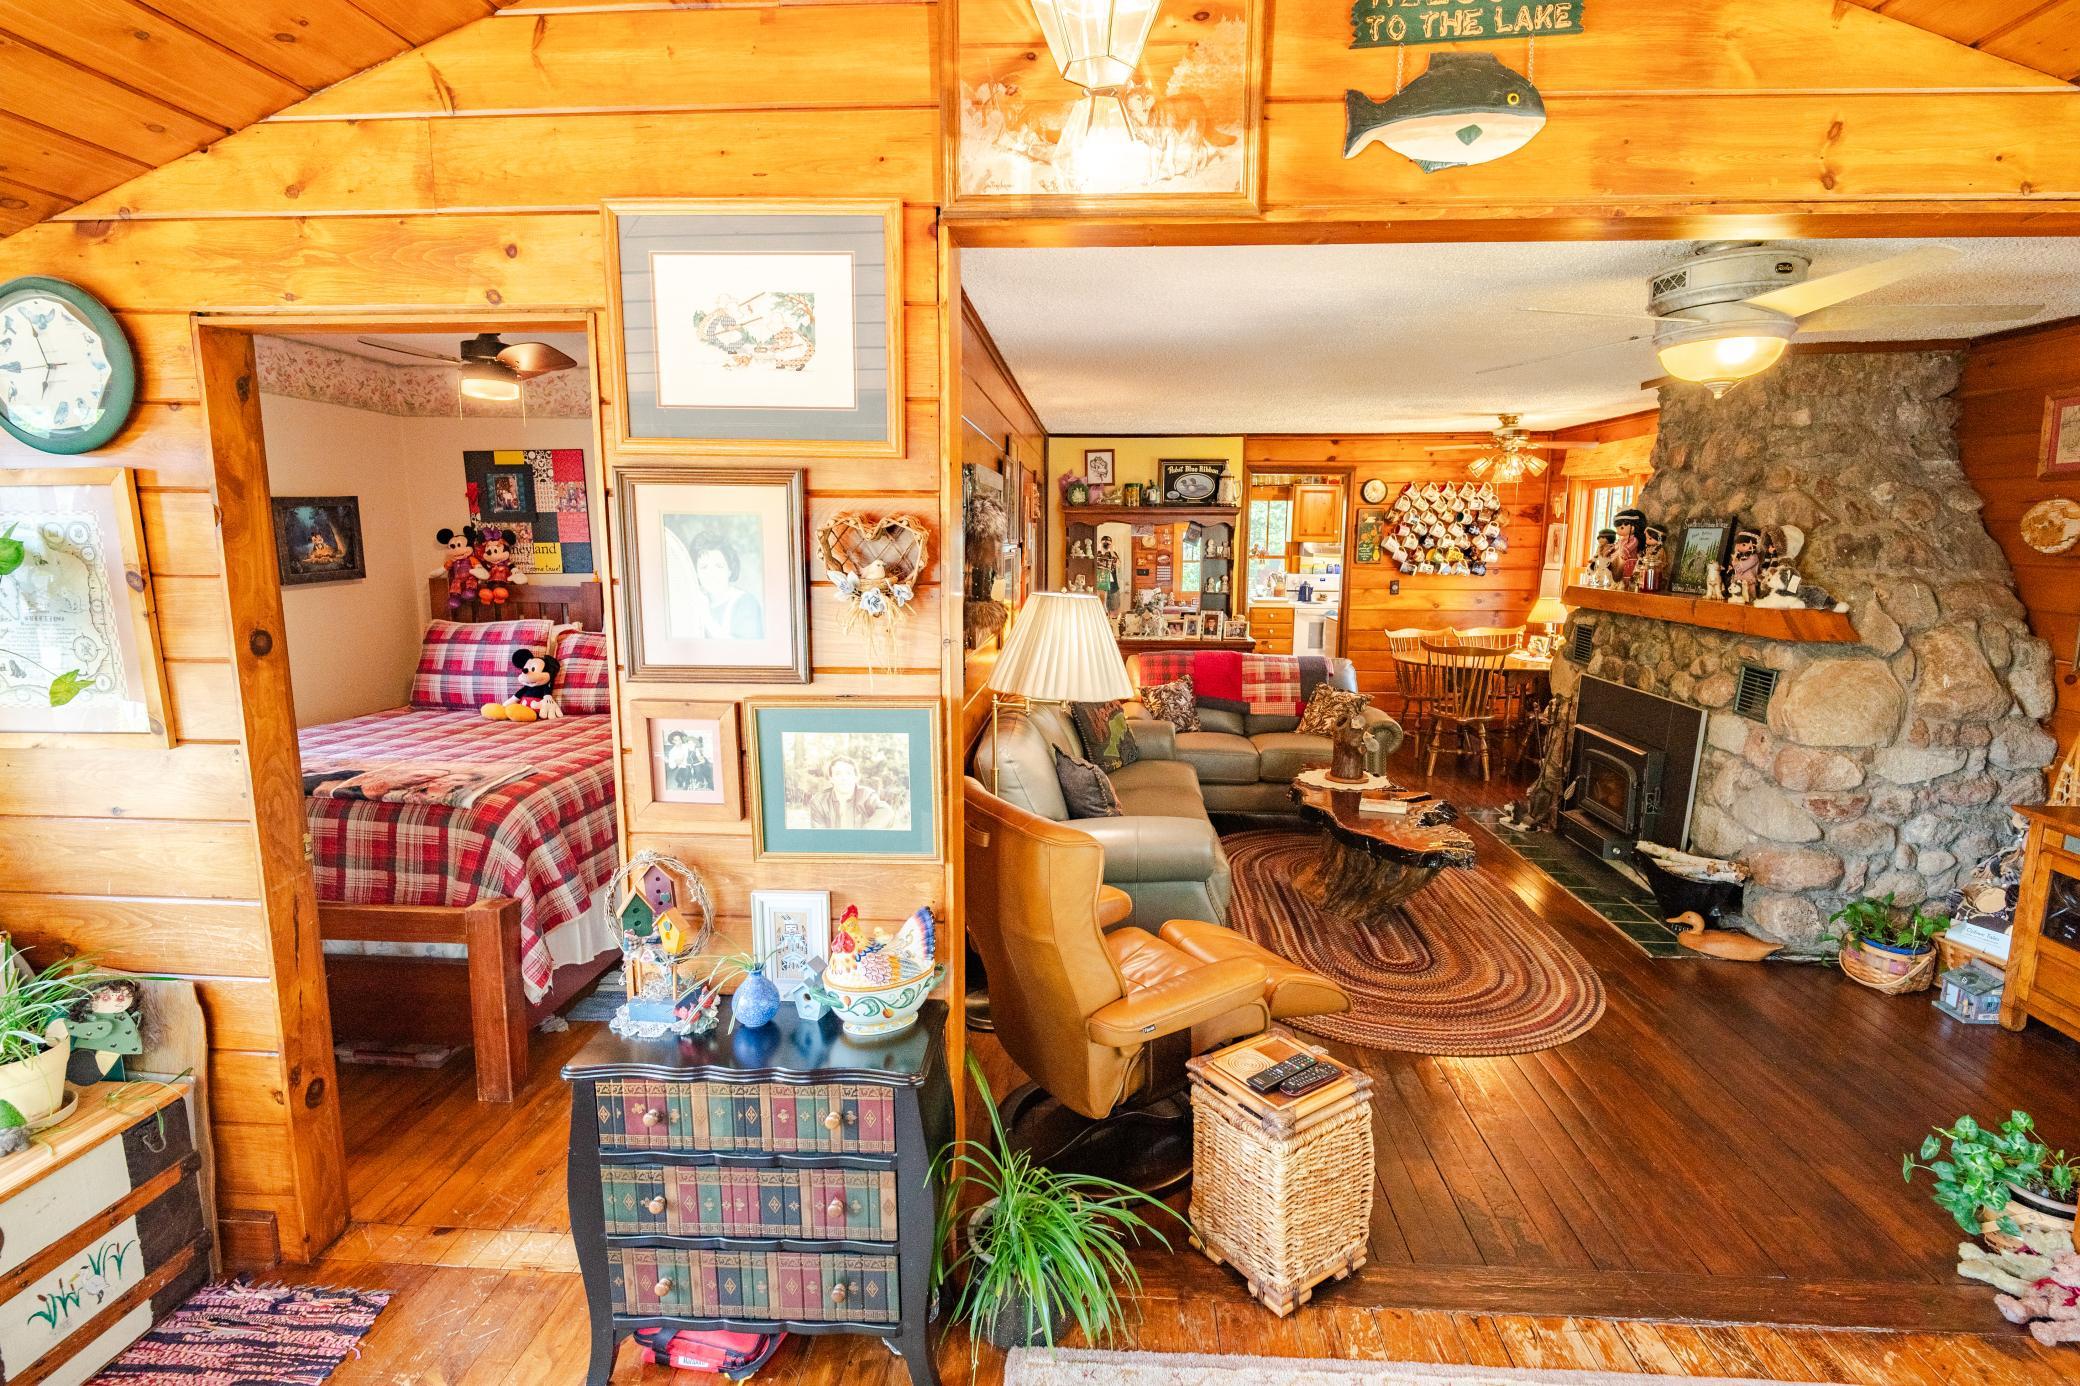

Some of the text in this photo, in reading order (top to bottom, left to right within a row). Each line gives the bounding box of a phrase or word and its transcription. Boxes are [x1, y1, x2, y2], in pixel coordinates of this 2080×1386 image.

[1366, 3, 1573, 42] TO THE LAKE
[1168, 466, 1184, 474] Pabst
[1199, 466, 1219, 474] Ribbon
[511, 543, 556, 557] neyland
